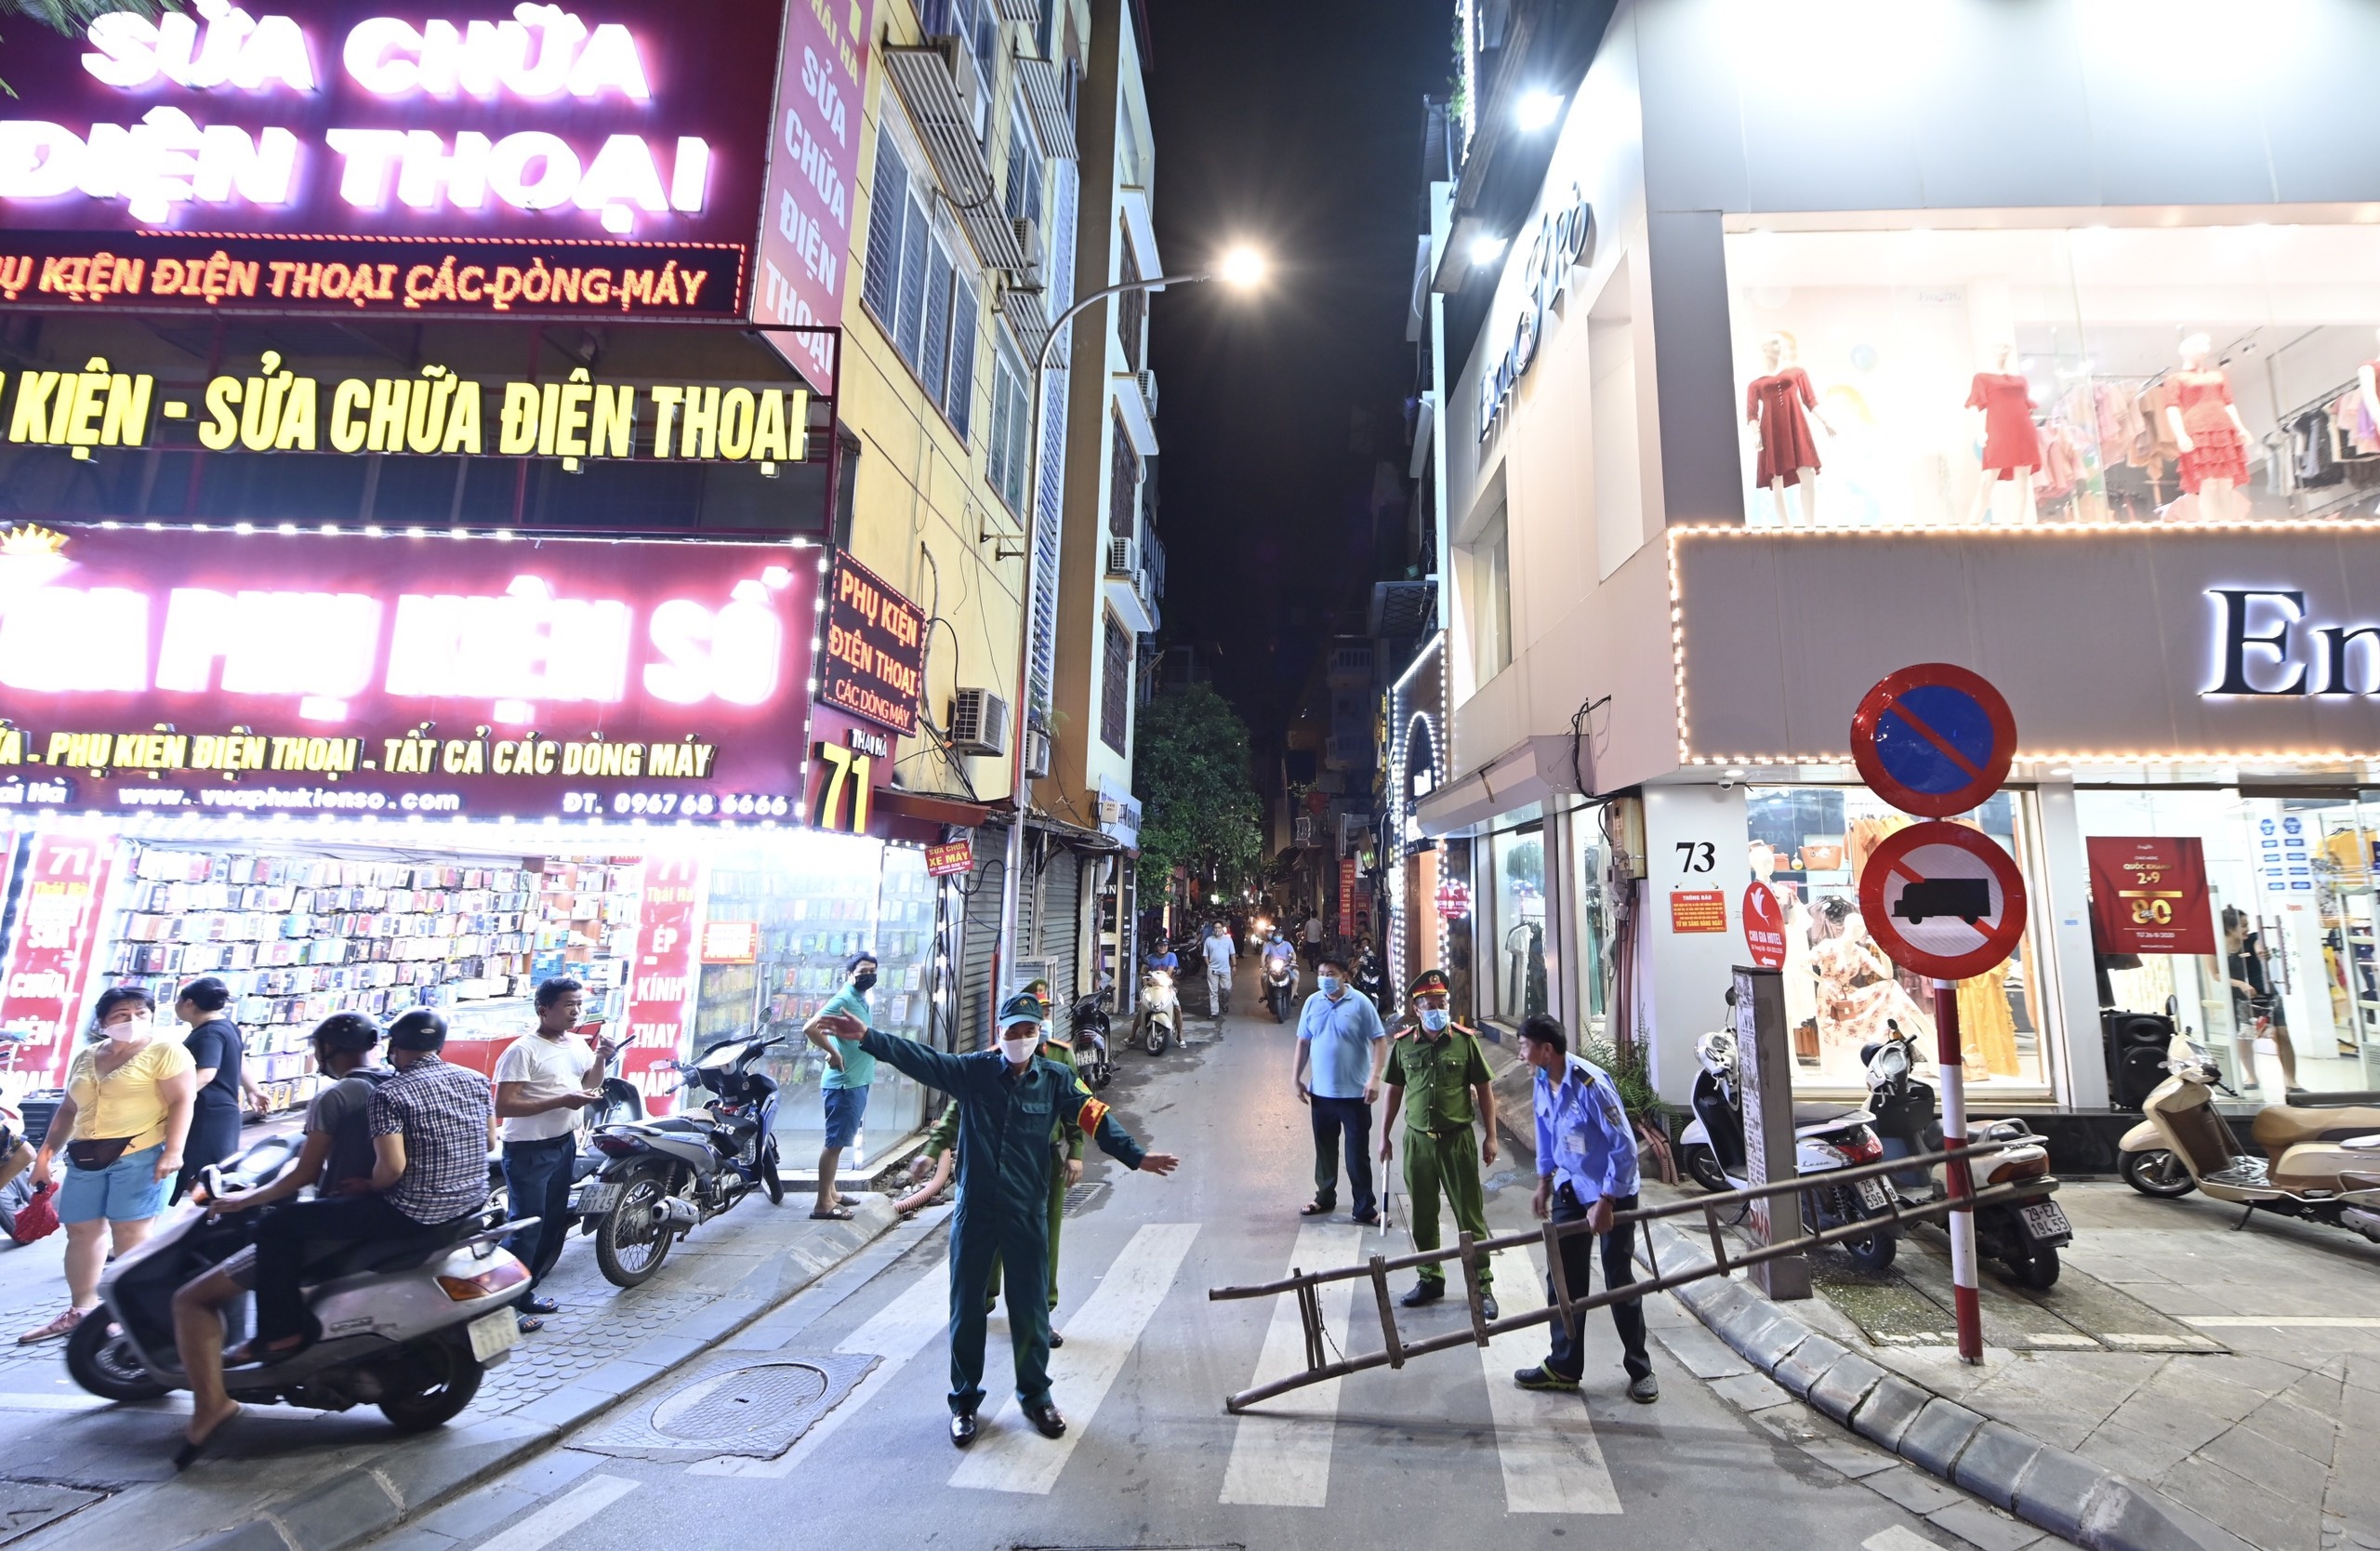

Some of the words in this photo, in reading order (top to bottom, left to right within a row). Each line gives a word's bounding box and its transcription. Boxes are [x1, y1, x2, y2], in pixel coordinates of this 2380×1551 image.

[82, 0, 316, 90] SỬA
[343, 2, 651, 99] CHỮA
[801, 46, 845, 149] SỬA
[325, 128, 710, 232] THOẠI
[785, 108, 845, 231] CHỮA
[779, 188, 837, 297] ĐIỆN
[151, 250, 259, 305] ĐIỆN
[267, 261, 399, 308] THOẠI
[765, 258, 835, 377] THOẠI
[8, 356, 154, 460] KIỆN
[198, 350, 317, 453] SỬA
[330, 365, 483, 455] CHỮA
[500, 368, 634, 474] ĐIỆN
[651, 384, 810, 477] THOẠI
[840, 568, 879, 627] PHỤ
[880, 597, 919, 648] KIỆN
[643, 565, 790, 705] SỐ
[829, 623, 874, 674] ĐIỆN
[875, 649, 917, 699] THOẠI
[835, 678, 860, 707] CÁC
[860, 689, 890, 722] DÒNG
[889, 703, 910, 728] MÁY
[46, 732, 110, 778] PHỤ
[112, 722, 188, 780] KIỆN
[191, 725, 268, 782] ĐIỆN
[271, 737, 359, 782] THOẠI
[384, 722, 438, 774] TẤT
[443, 725, 488, 776] CẢ
[493, 731, 556, 776] CÁC
[562, 731, 643, 777] DÒNG
[649, 733, 714, 778] MÁY
[721, 795, 788, 816] 6666
[821, 741, 870, 834] 71
[49, 846, 89, 875] 71
[929, 856, 944, 868] XE
[945, 851, 969, 864] MÁY
[1675, 842, 1716, 873] 73
[2131, 899, 2172, 924] 80
[652, 923, 678, 953] ÉP
[1766, 932, 1782, 946] HOTEL
[637, 972, 683, 1001] KÍNH
[631, 1023, 680, 1049] THAY
[577, 1198, 614, 1212] 301.45
[586, 1185, 615, 1199] 29-H1
[2026, 1203, 2057, 1222] 29-E2
[2030, 1216, 2069, 1236] 194.55
